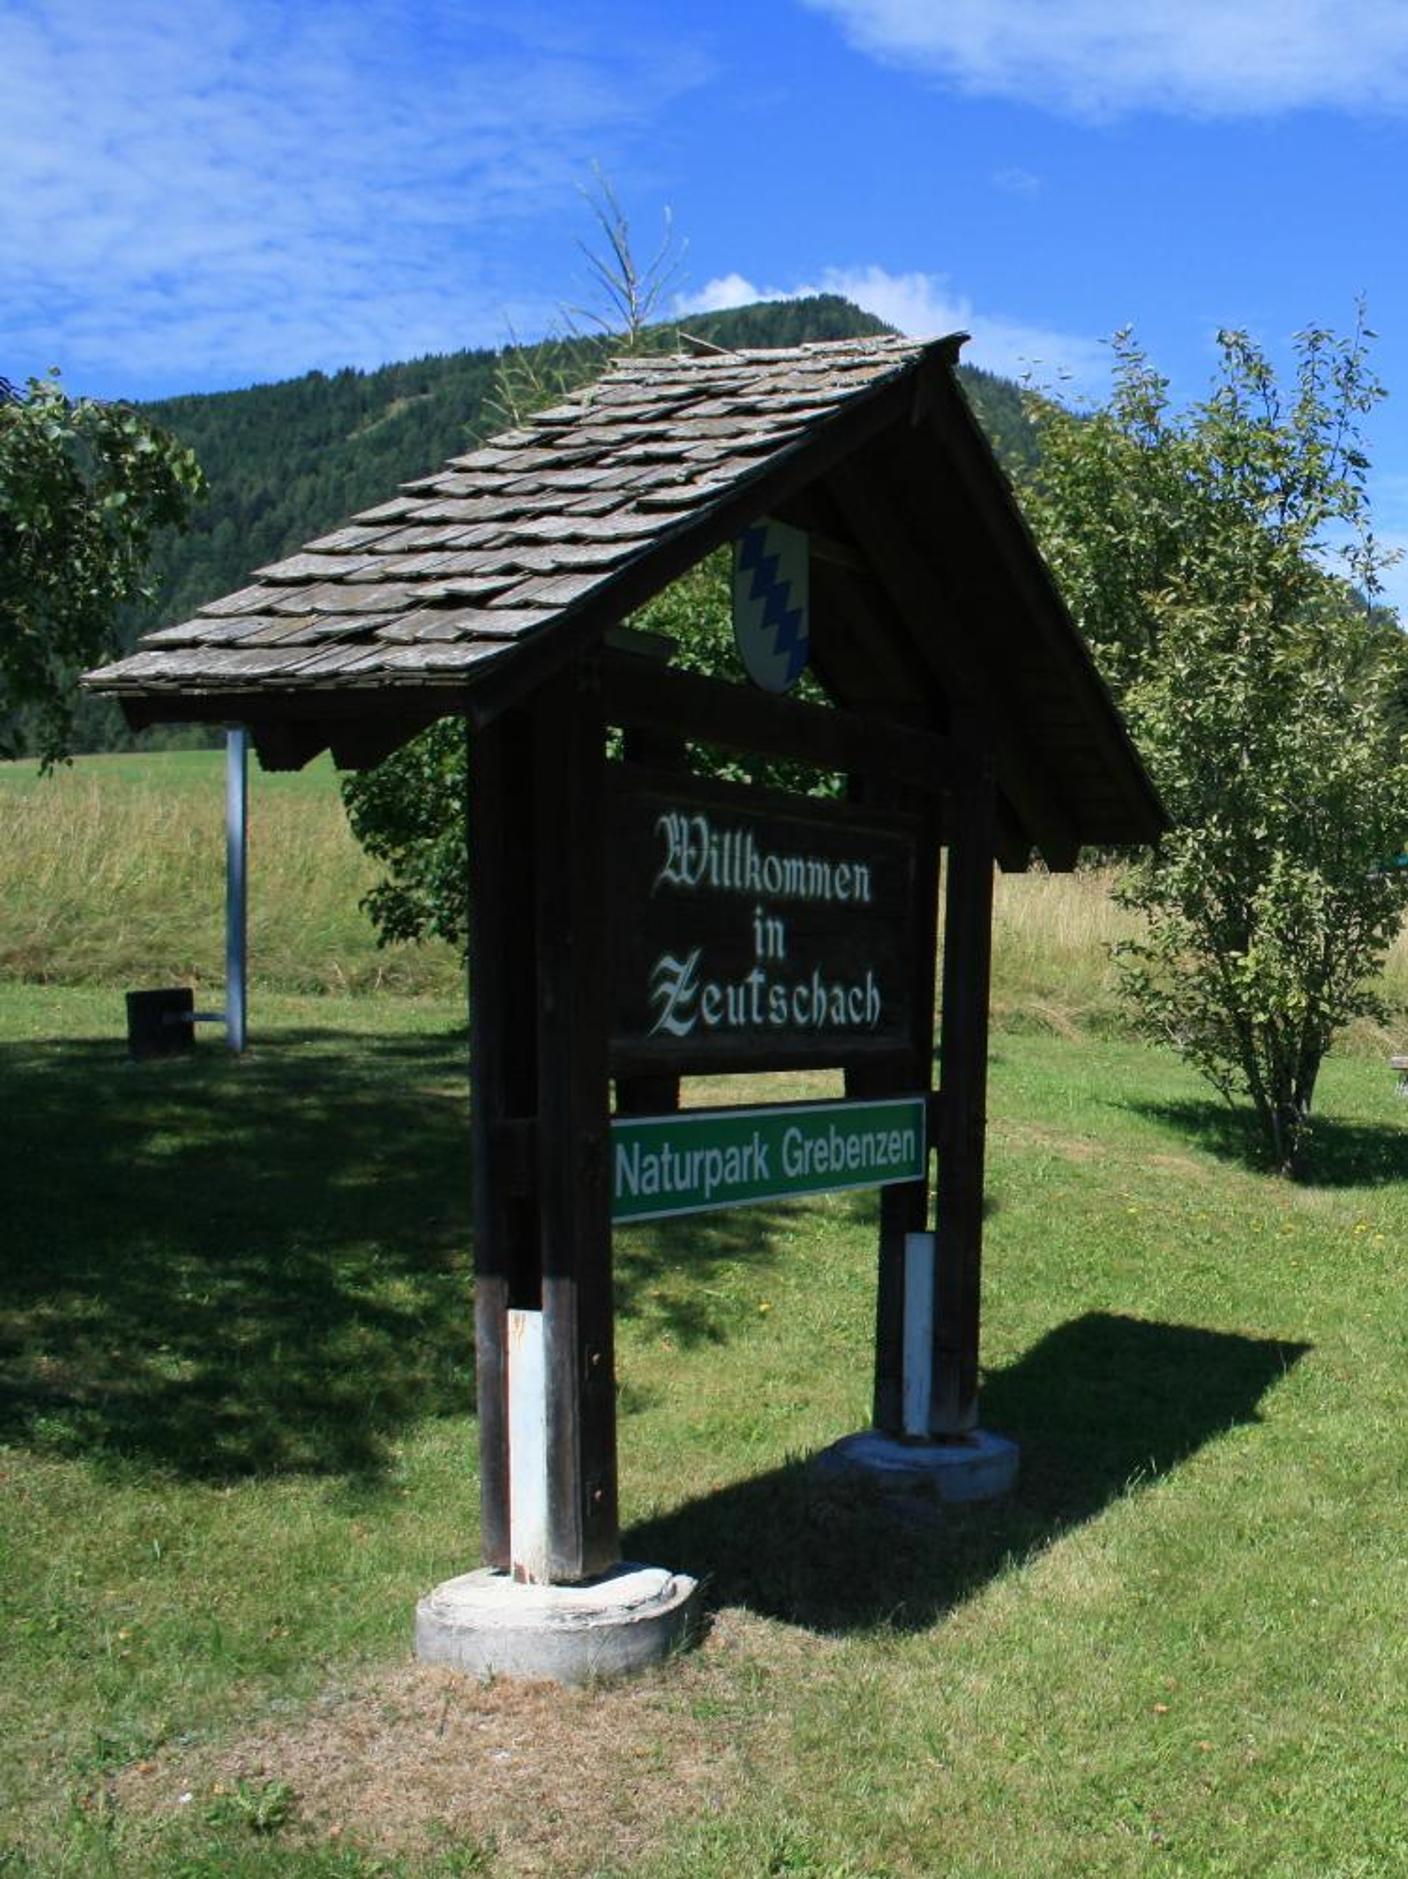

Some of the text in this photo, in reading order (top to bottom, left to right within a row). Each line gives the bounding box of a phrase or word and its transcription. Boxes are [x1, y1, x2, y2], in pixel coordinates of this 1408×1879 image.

[653, 811, 871, 902] Willkommen
[753, 904, 786, 960] in
[649, 947, 881, 1037] Zeutschach
[615, 1125, 916, 1198] Naturpark Grebenzen
